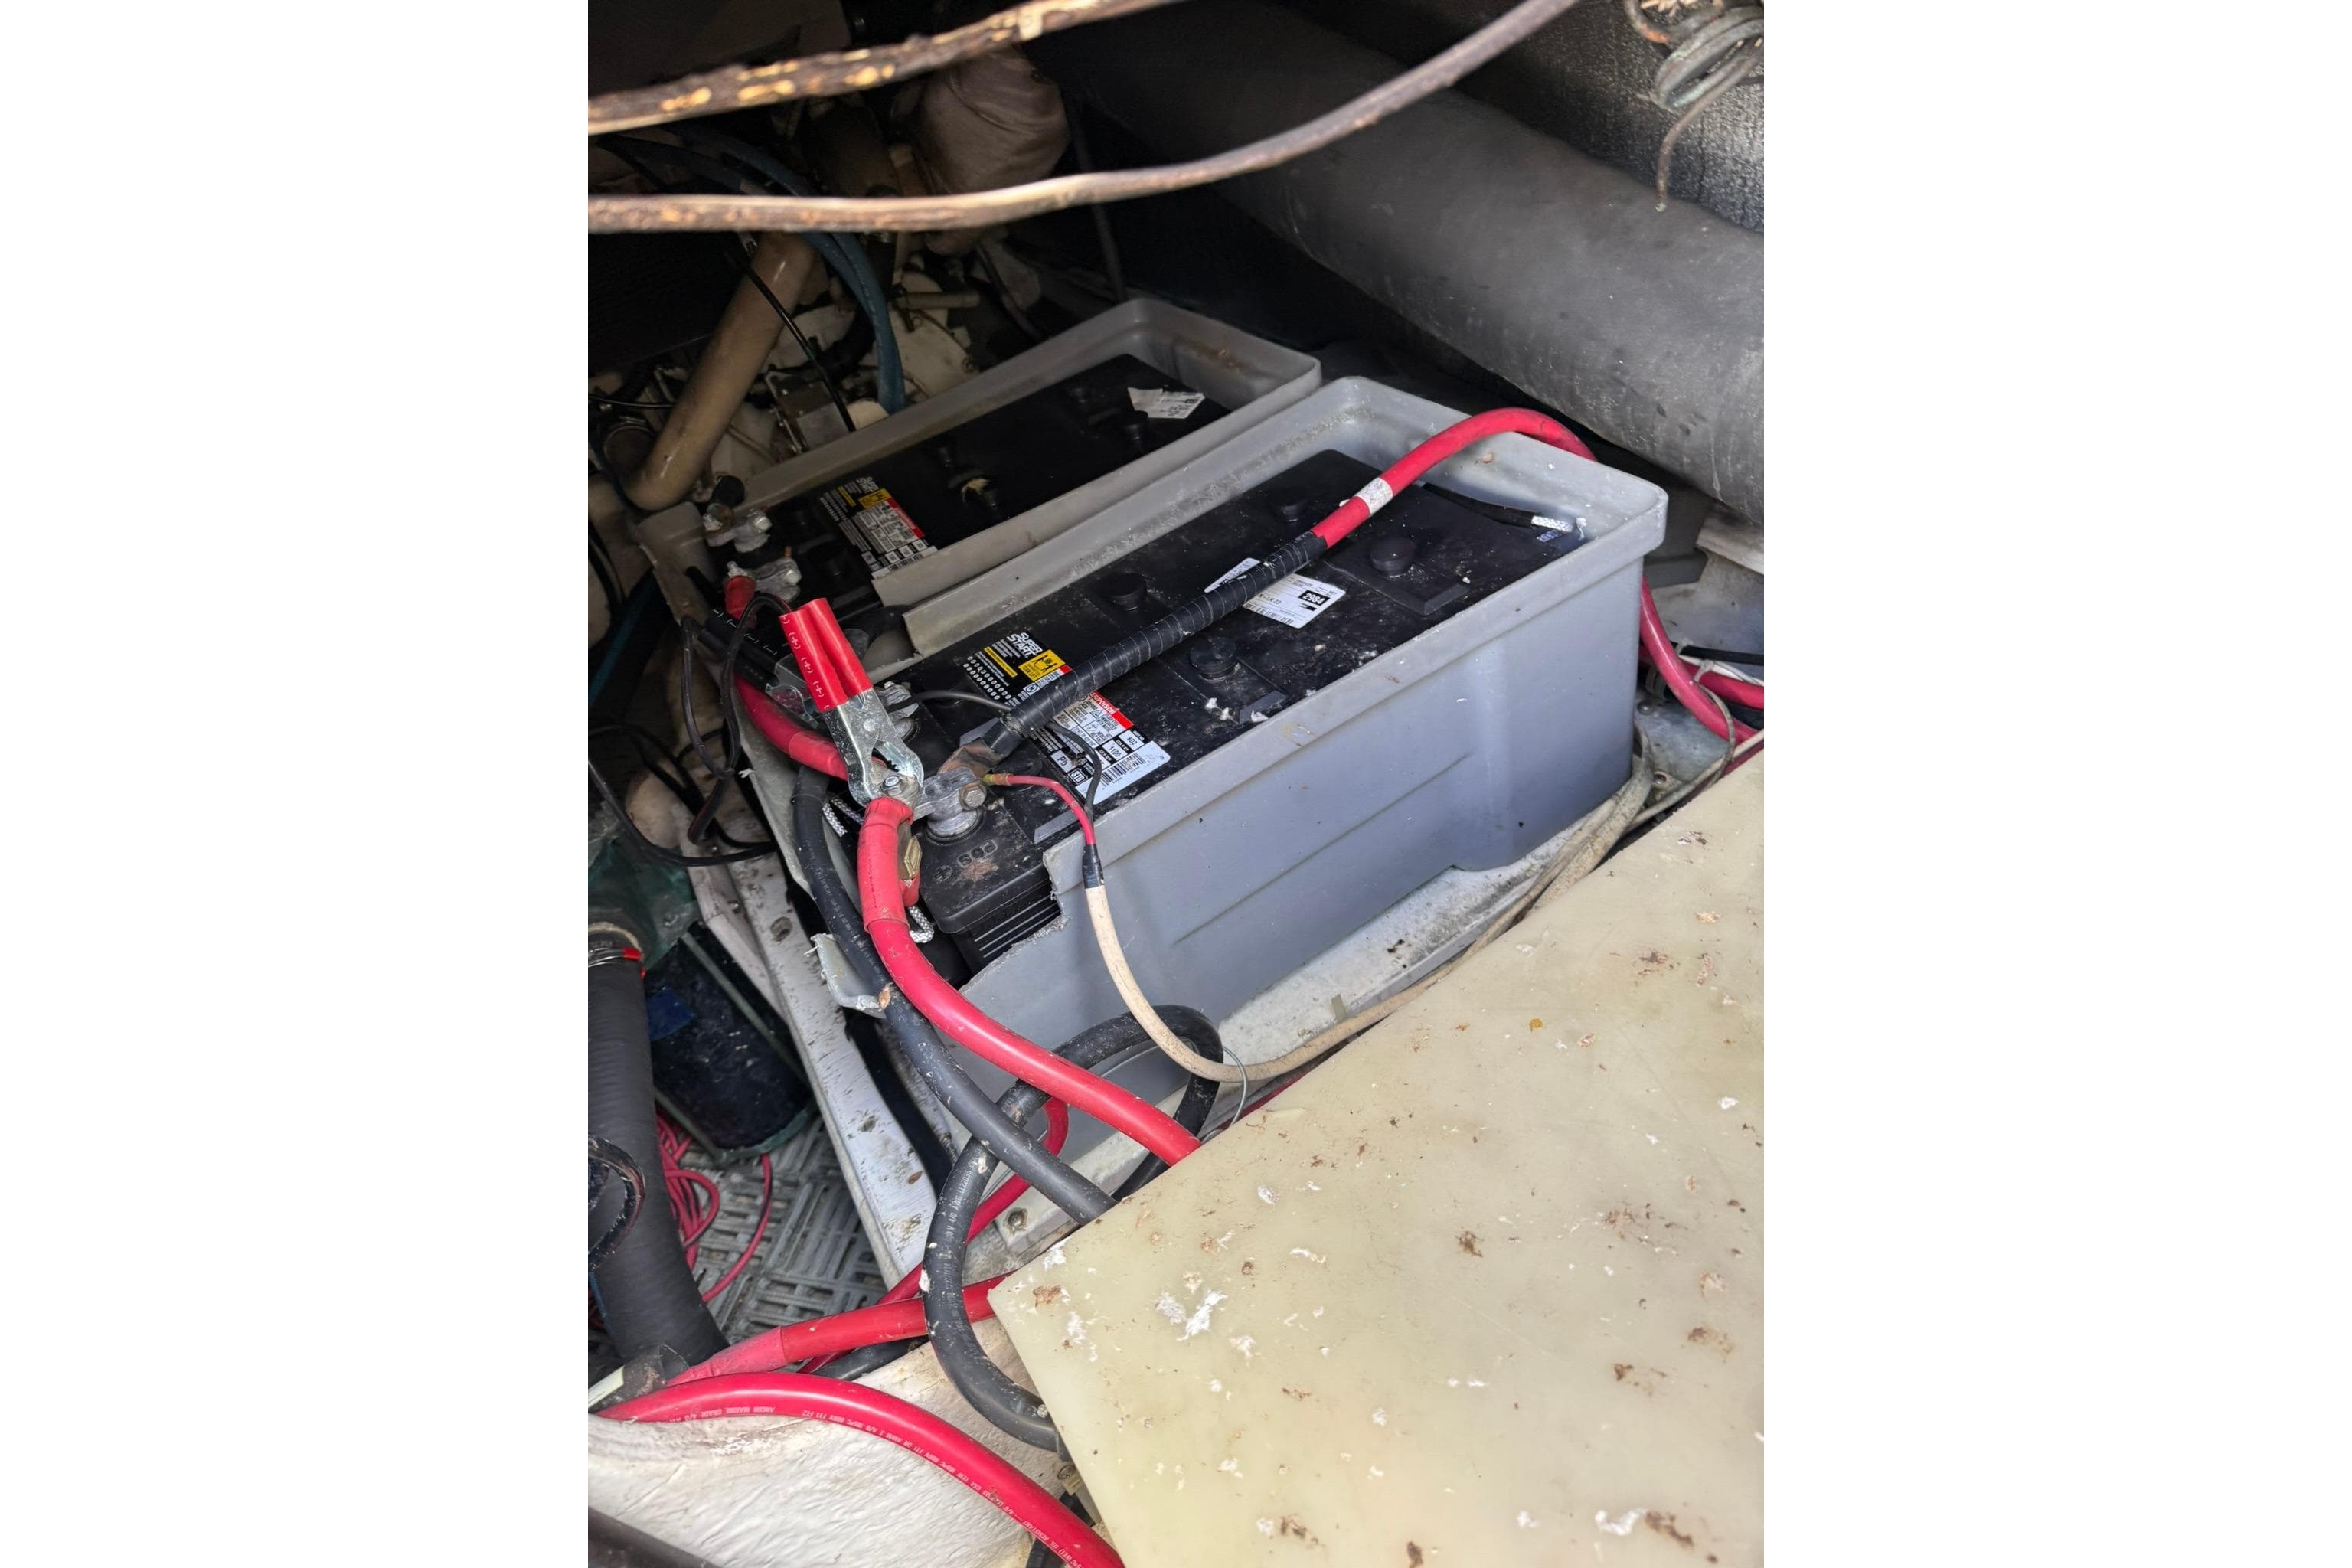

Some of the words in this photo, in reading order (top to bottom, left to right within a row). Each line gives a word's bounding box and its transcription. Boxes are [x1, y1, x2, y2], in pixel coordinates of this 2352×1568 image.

[1302, 592, 1324, 604] 2984
[1006, 633, 1031, 658] START
[1020, 632, 1043, 654] SUPER
[1107, 745, 1121, 758] 1100
[1057, 755, 1069, 766] Pb
[700, 1408, 721, 1416] GRADE
[1021, 1518, 1050, 1541] RESISTANT
